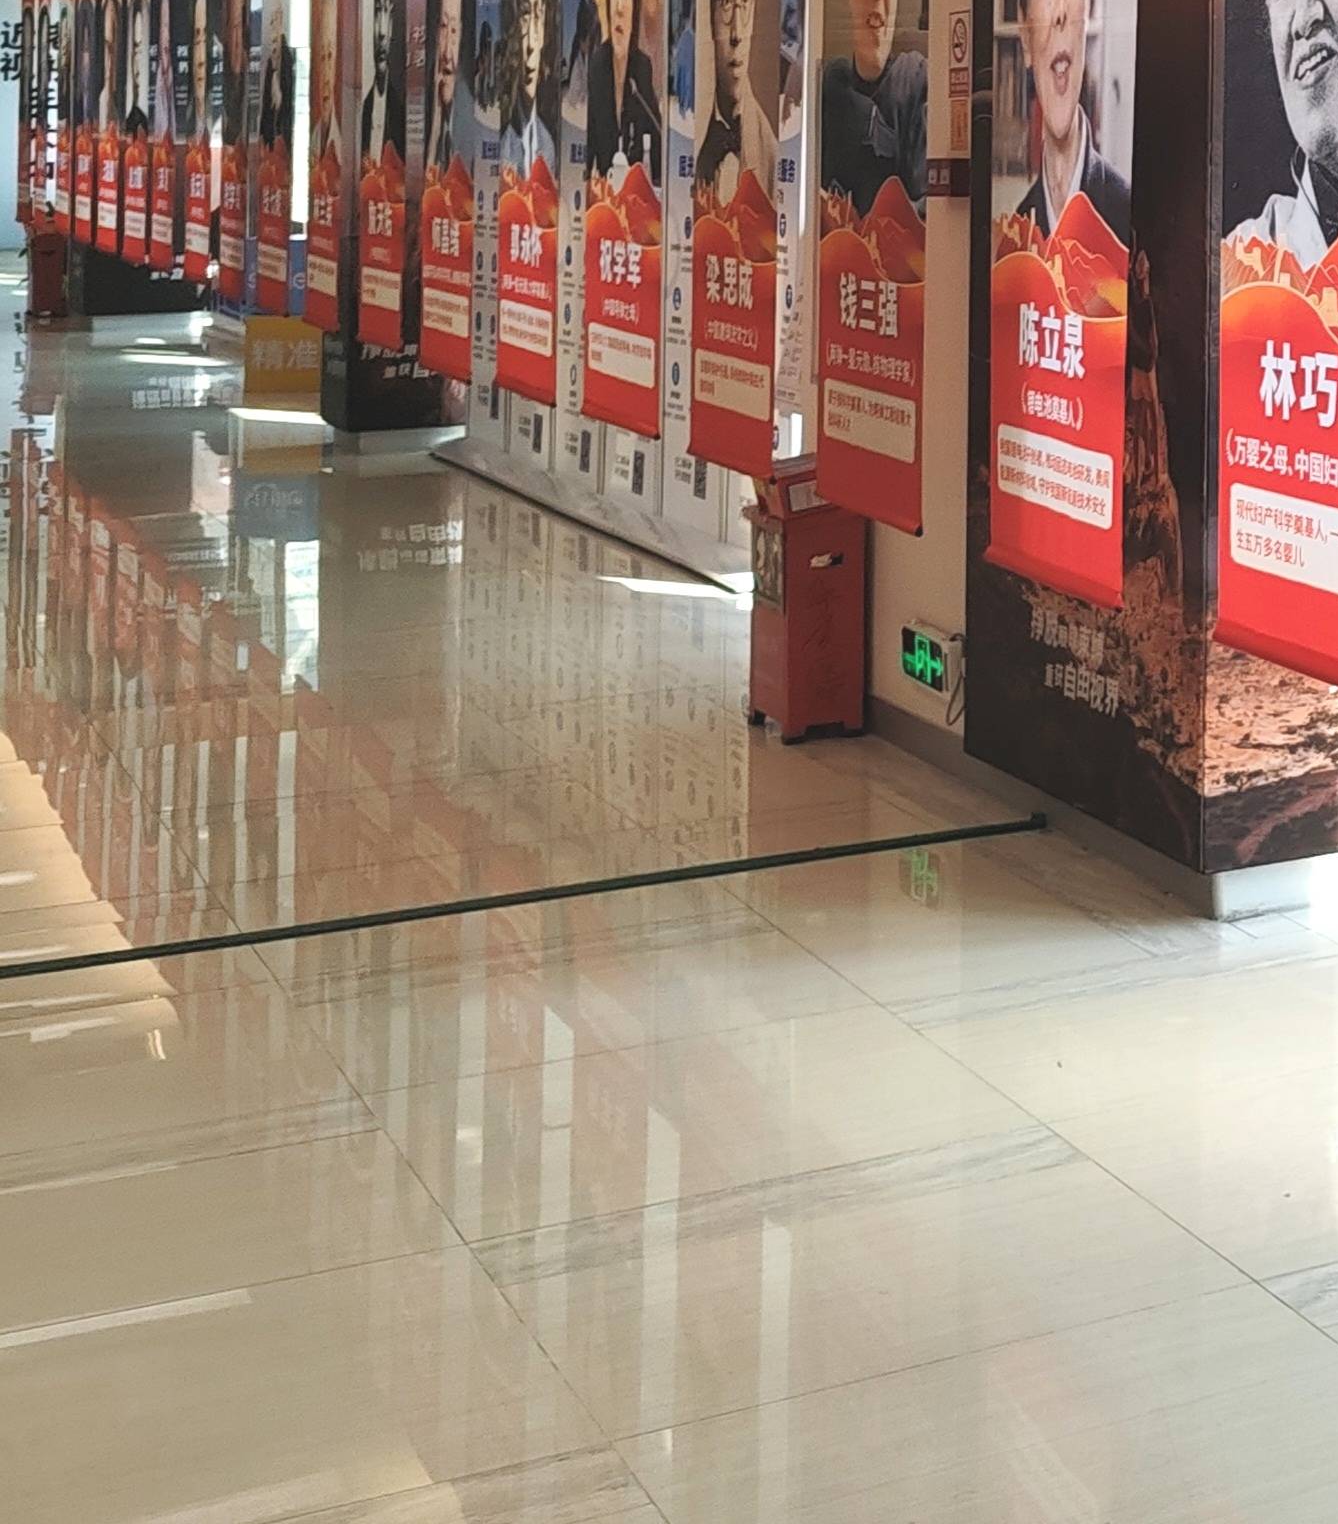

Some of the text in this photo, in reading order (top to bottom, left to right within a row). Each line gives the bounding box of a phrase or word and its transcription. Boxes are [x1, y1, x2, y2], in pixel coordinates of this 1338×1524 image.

[600, 238, 642, 289] 祝学军
[706, 254, 753, 310] 梁思成
[840, 272, 898, 338] 钱三强
[1018, 302, 1085, 379] 陈立泉
